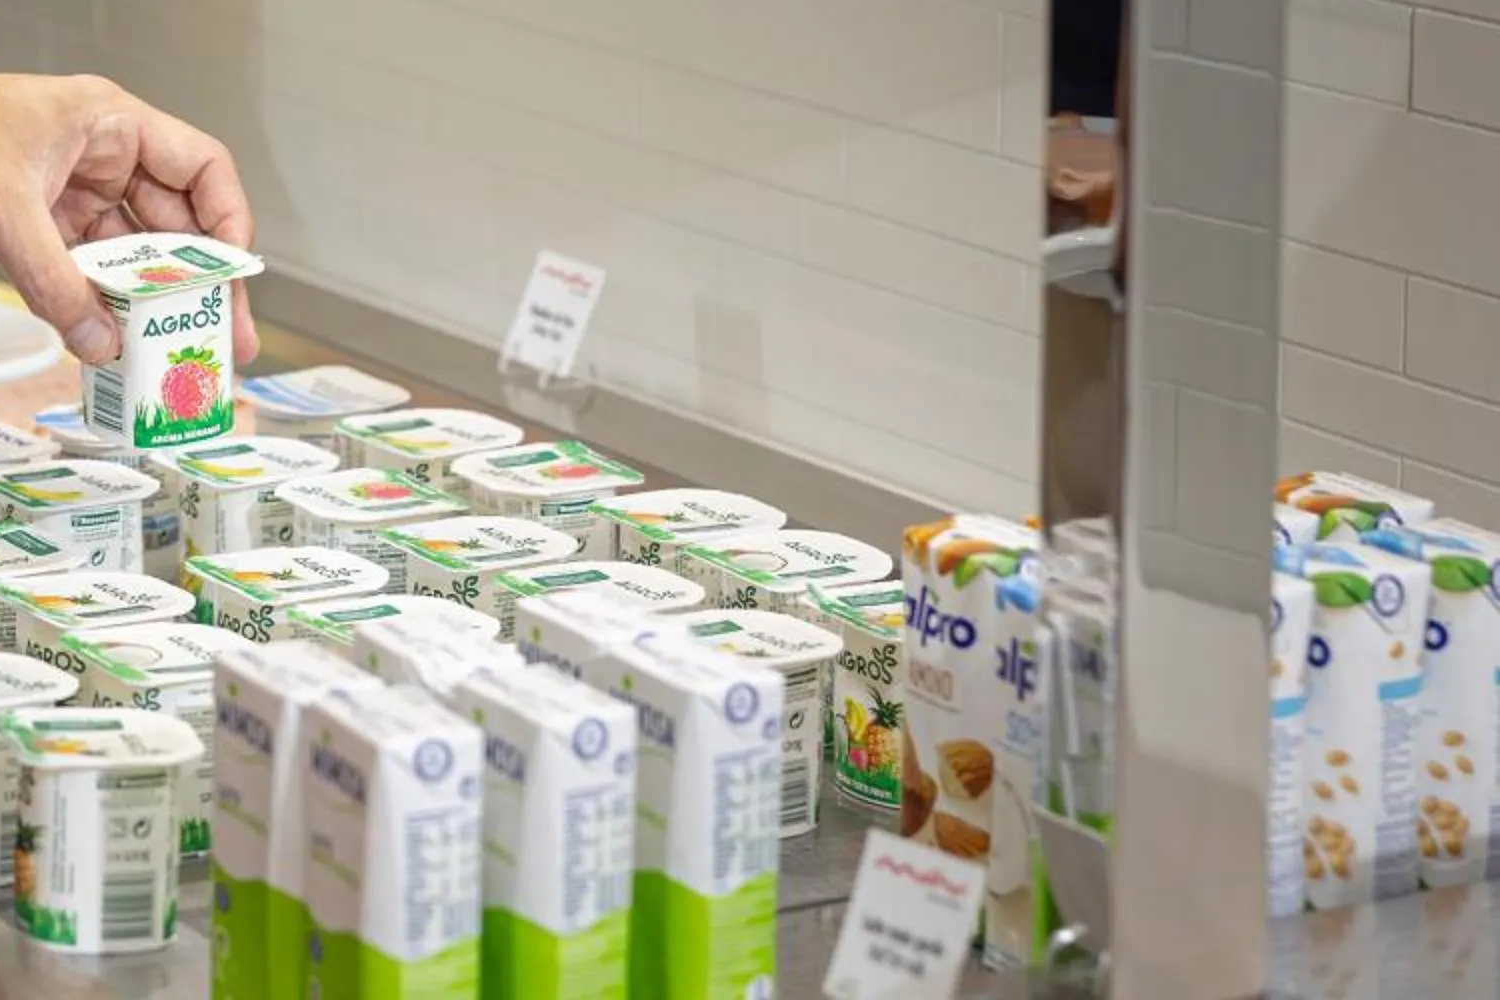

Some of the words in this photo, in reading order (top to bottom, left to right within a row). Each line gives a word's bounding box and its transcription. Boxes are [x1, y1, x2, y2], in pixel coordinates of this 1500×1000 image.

[143, 286, 223, 338] AGROS
[905, 586, 976, 649] alpro
[996, 636, 1037, 701] alp
